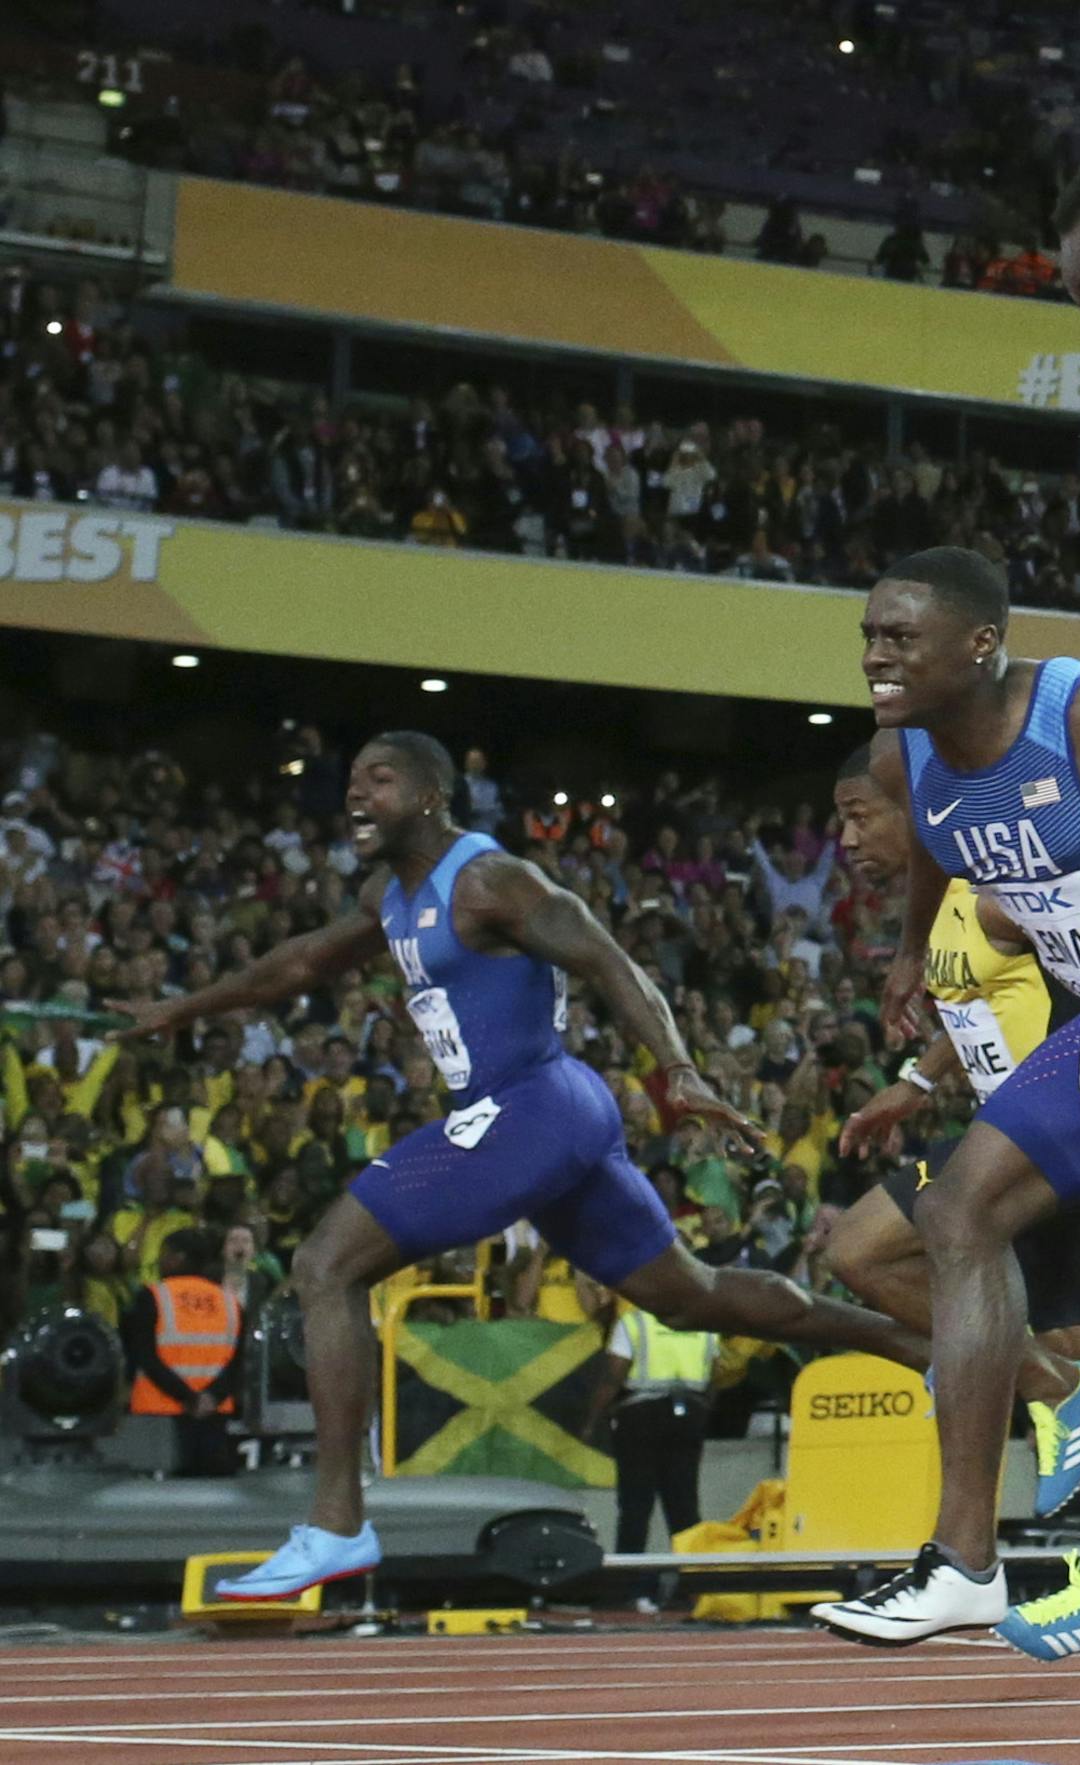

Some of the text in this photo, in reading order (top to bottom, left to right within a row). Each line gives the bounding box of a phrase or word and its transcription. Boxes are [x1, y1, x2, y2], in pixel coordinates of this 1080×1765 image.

[953, 818, 1063, 882] USA
[1002, 887, 1074, 913] TDK
[961, 1041, 1008, 1076] AKE
[810, 1391, 914, 1420] SEIKO
